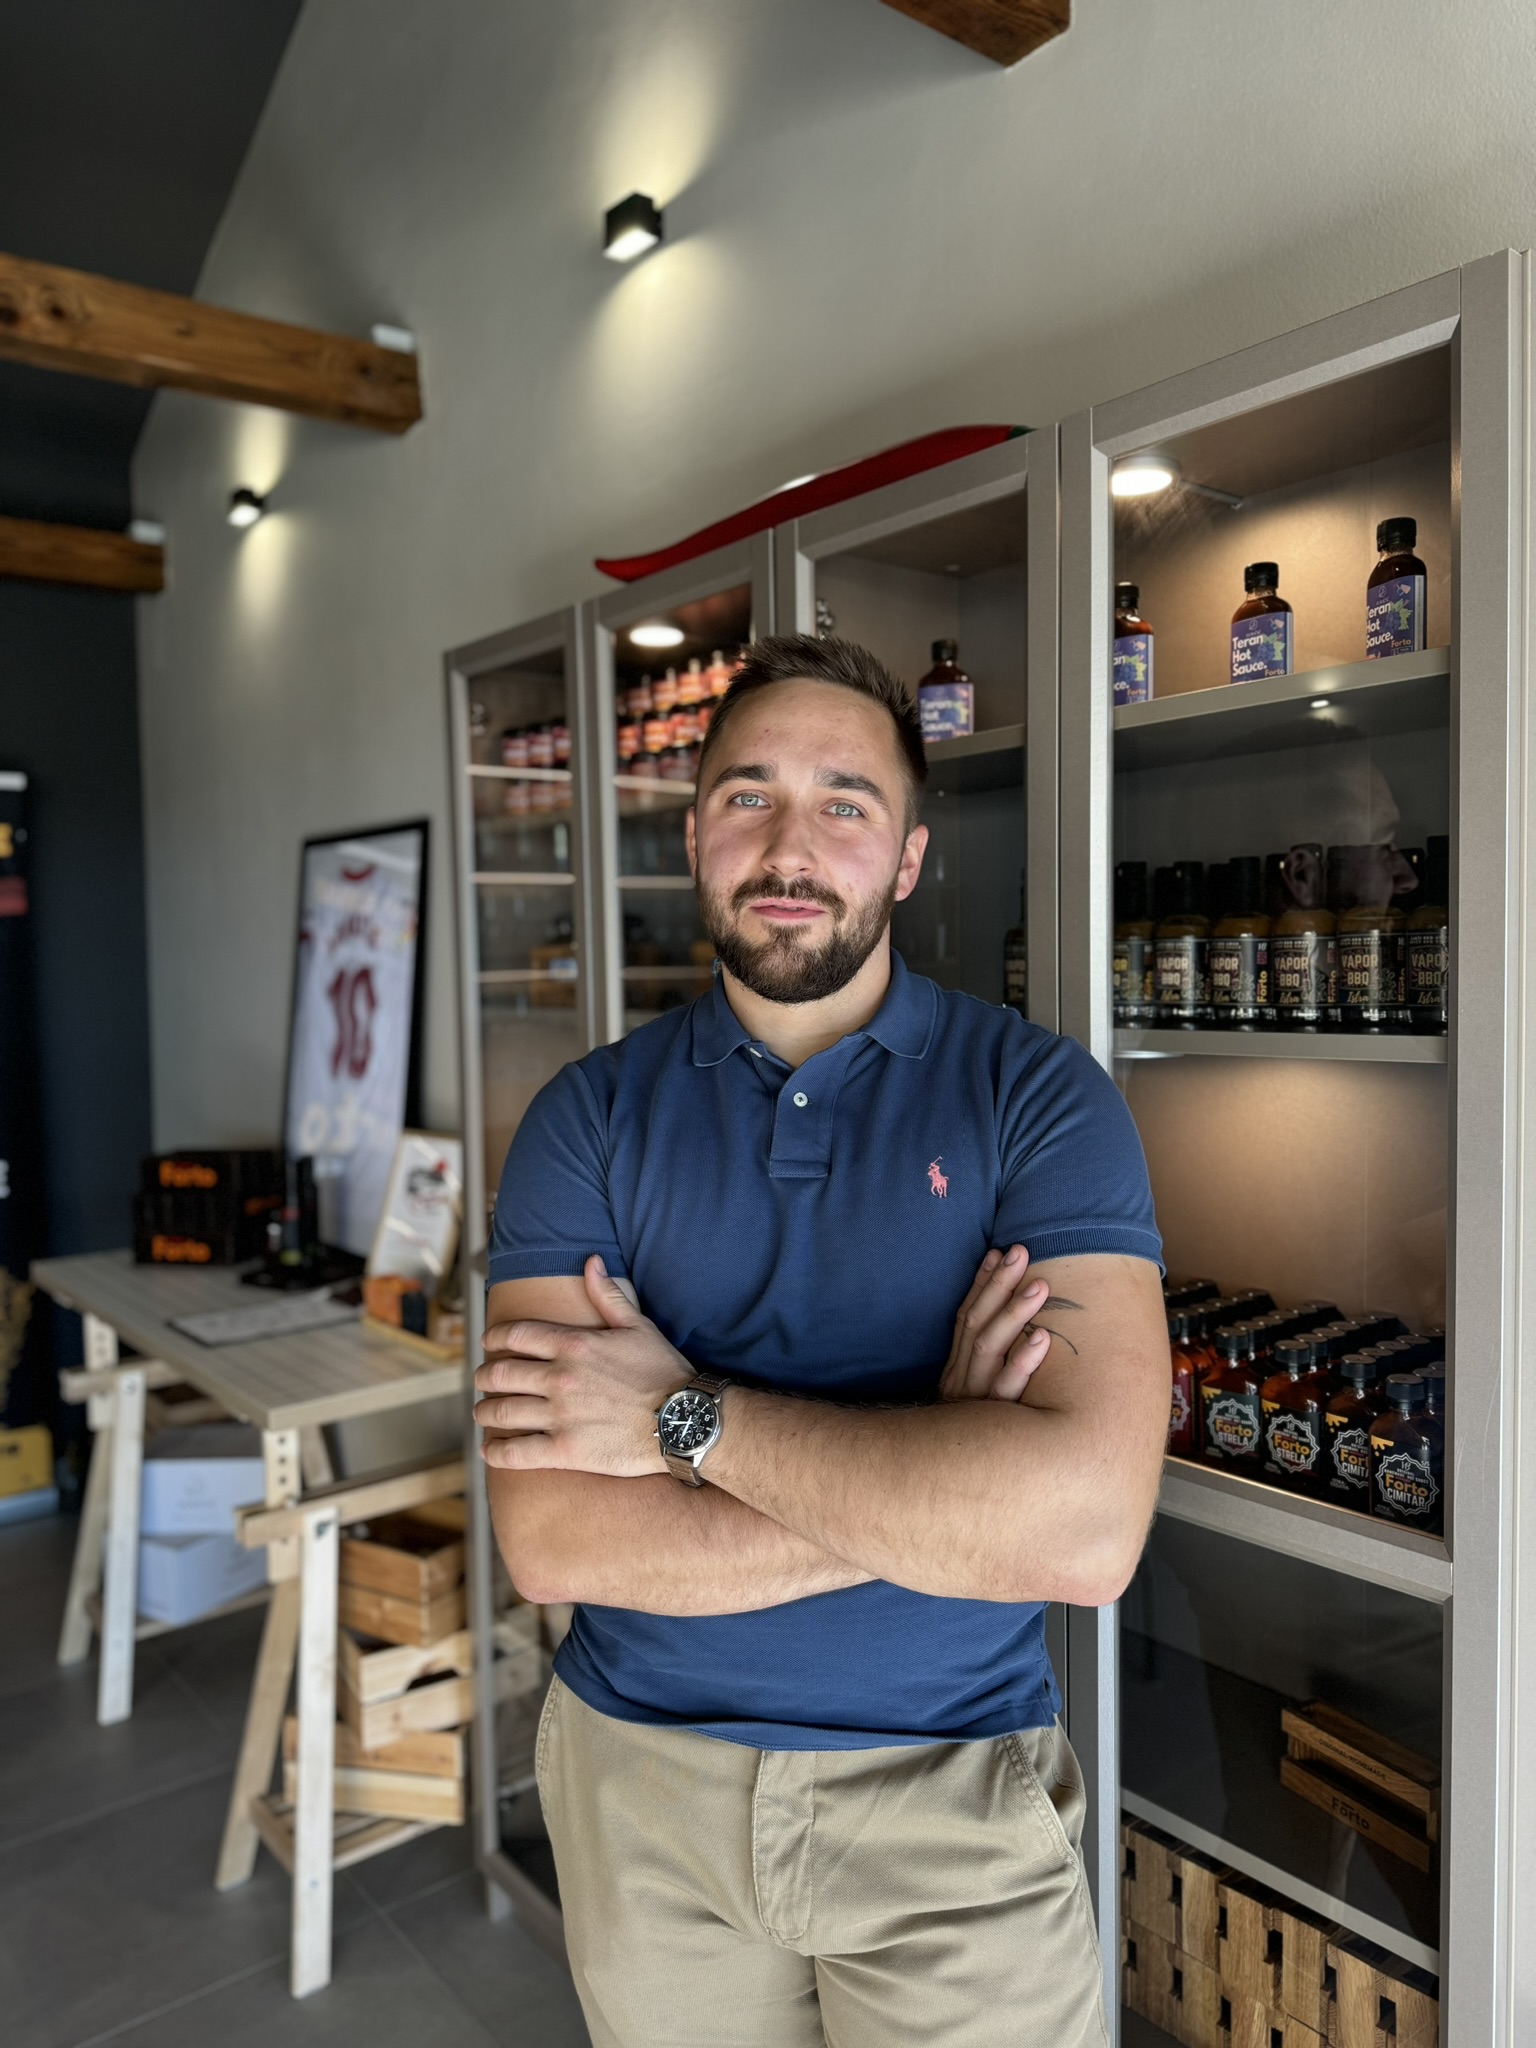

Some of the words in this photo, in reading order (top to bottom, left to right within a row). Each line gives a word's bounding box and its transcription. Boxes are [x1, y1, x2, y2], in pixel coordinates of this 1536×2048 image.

[1232, 635, 1263, 650] Teran
[1391, 639, 1411, 648] Forto
[1232, 649, 1251, 664] Hot
[1232, 661, 1267, 677] Sauce.
[1264, 669, 1285, 677] Forto
[1157, 957, 1189, 970] VAPOR
[1274, 957, 1309, 970] VAPOR
[1341, 954, 1378, 968] VAPOR
[1411, 953, 1442, 968] VAPO
[1161, 972, 1180, 986] BBQ
[1213, 973, 1230, 987] BBQ
[1280, 973, 1299, 987] BBQ
[1347, 971, 1369, 987] BBQ
[1418, 971, 1441, 986] BBQ
[1257, 971, 1268, 1003] Forto
[1216, 1418, 1253, 1437] Forto
[1218, 1432, 1249, 1446] STRELA
[1274, 1434, 1310, 1455] Forto
[1277, 1447, 1305, 1464] STRELA
[1341, 1448, 1368, 1467] For
[1342, 1462, 1368, 1478] CIMIT
[1385, 1473, 1428, 1497] Forto
[1387, 1488, 1425, 1507] CIMITAR
[1332, 1796, 1370, 1829] Forto
